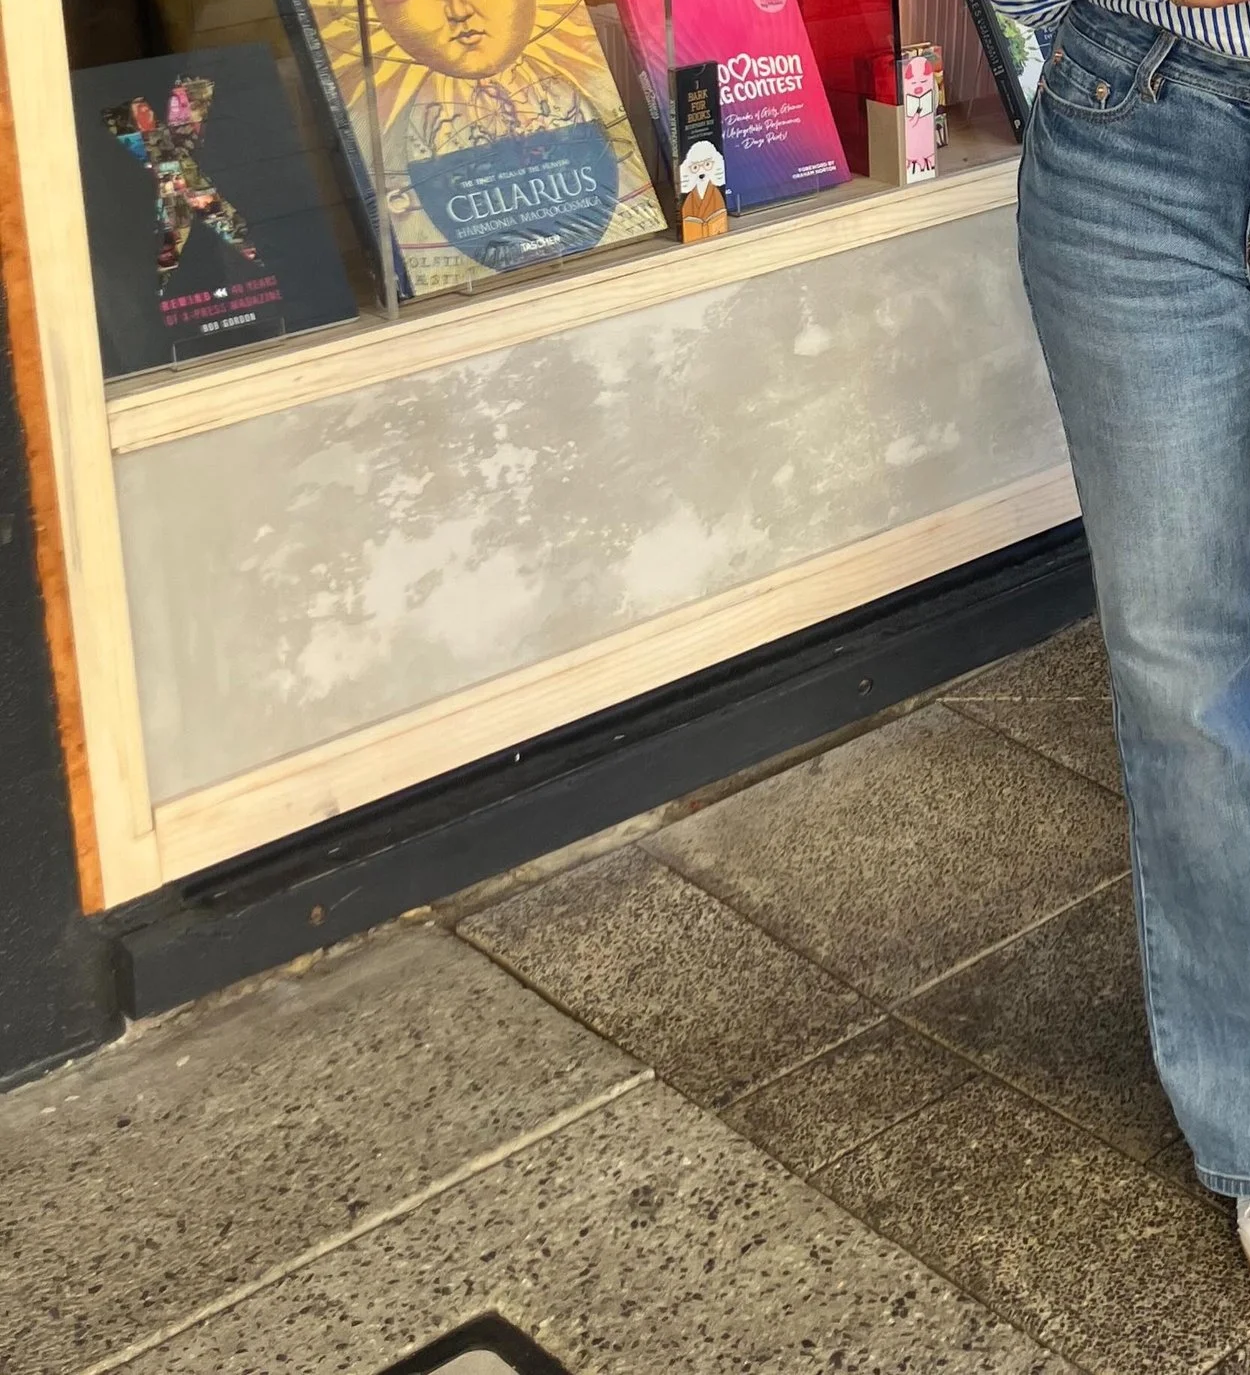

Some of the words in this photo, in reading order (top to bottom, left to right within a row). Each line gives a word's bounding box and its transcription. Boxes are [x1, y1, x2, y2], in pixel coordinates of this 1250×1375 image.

[688, 89, 709, 102] BARK
[734, 74, 804, 104] CONTEST
[691, 100, 707, 112] FOR
[687, 109, 712, 124] BOOKS
[792, 170, 816, 180] GRAHAM
[815, 166, 837, 175] NORTON
[797, 162, 828, 172] FOREWORD
[460, 179, 475, 189] THE
[447, 166, 598, 224] CELLARIUS
[456, 216, 517, 240] HARMONIA
[520, 195, 602, 224] MACROCOSMICA
[519, 234, 561, 253] TASCHEN
[161, 291, 212, 313] REWIND
[247, 274, 278, 290] YEARS
[229, 288, 283, 311] MAGAZINE
[222, 312, 257, 328] GORDON
